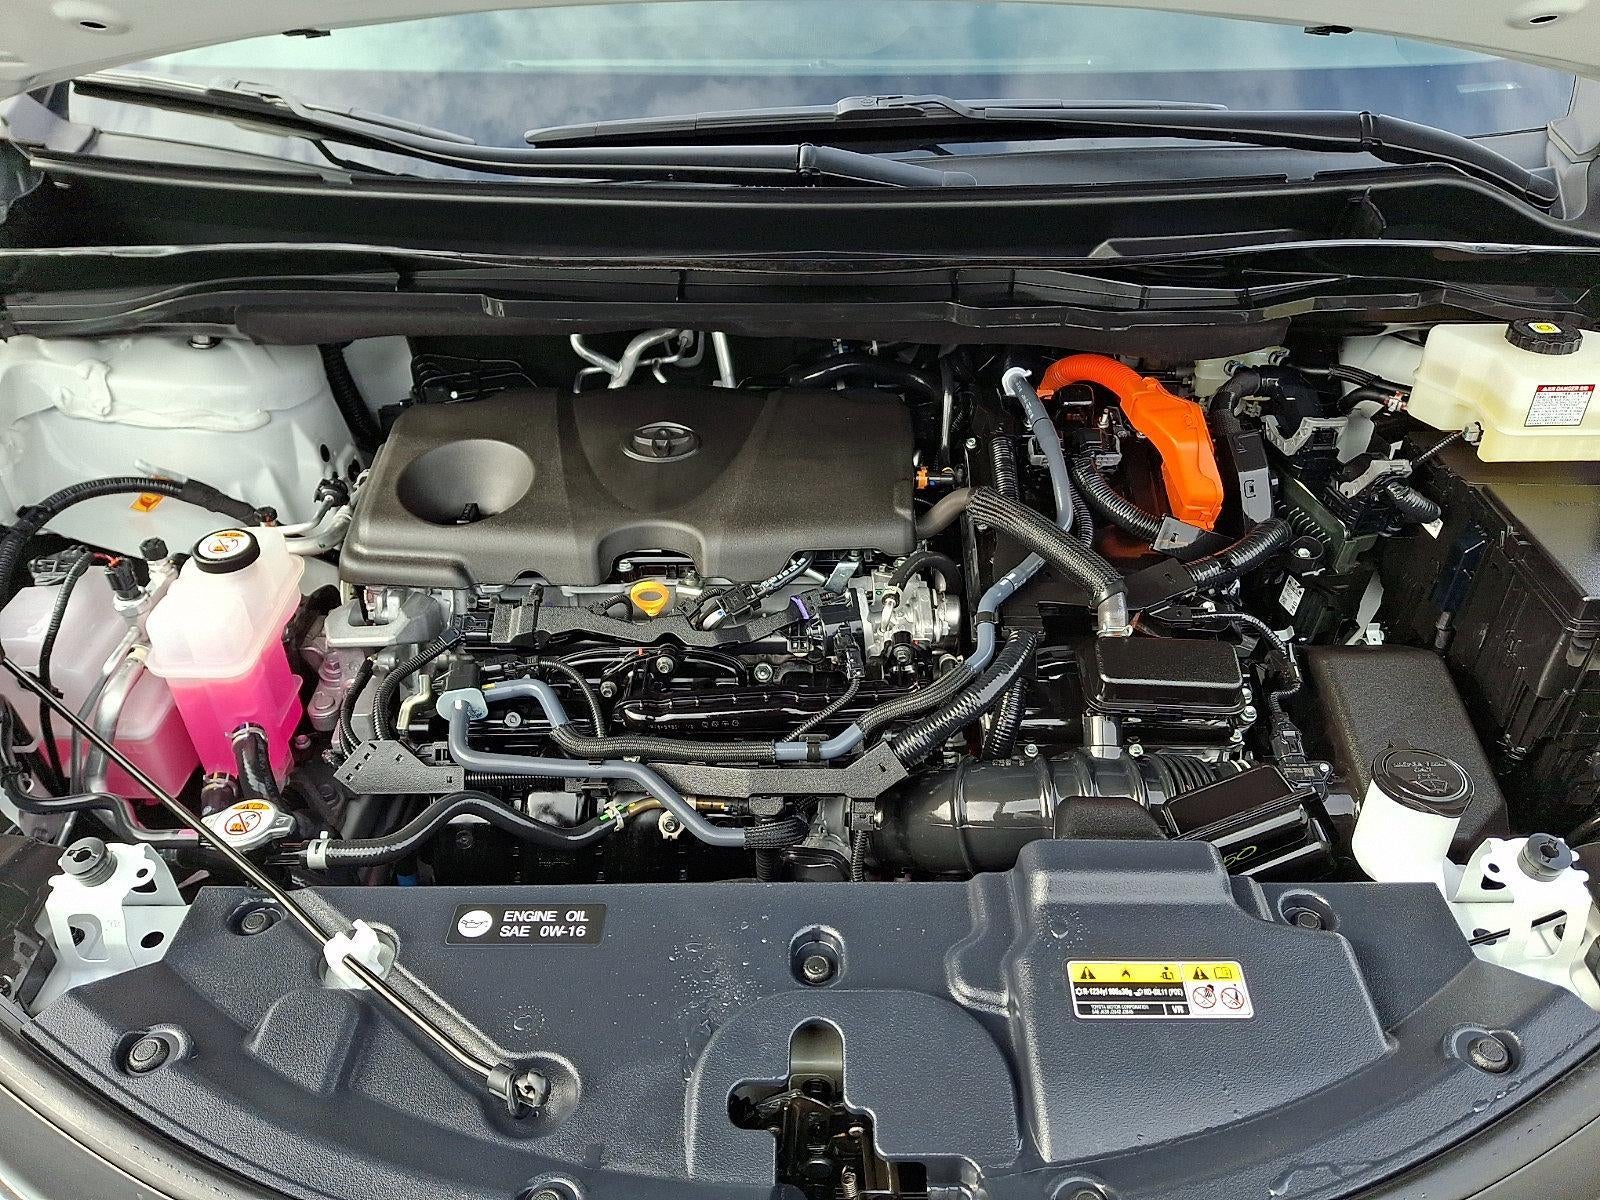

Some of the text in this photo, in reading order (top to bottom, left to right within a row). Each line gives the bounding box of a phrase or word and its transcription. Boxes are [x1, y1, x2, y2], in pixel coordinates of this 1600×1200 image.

[503, 910, 589, 922] ENGINE OIL
[500, 925, 586, 937] SAE 0W-16
[1171, 1005, 1184, 1014] VR
